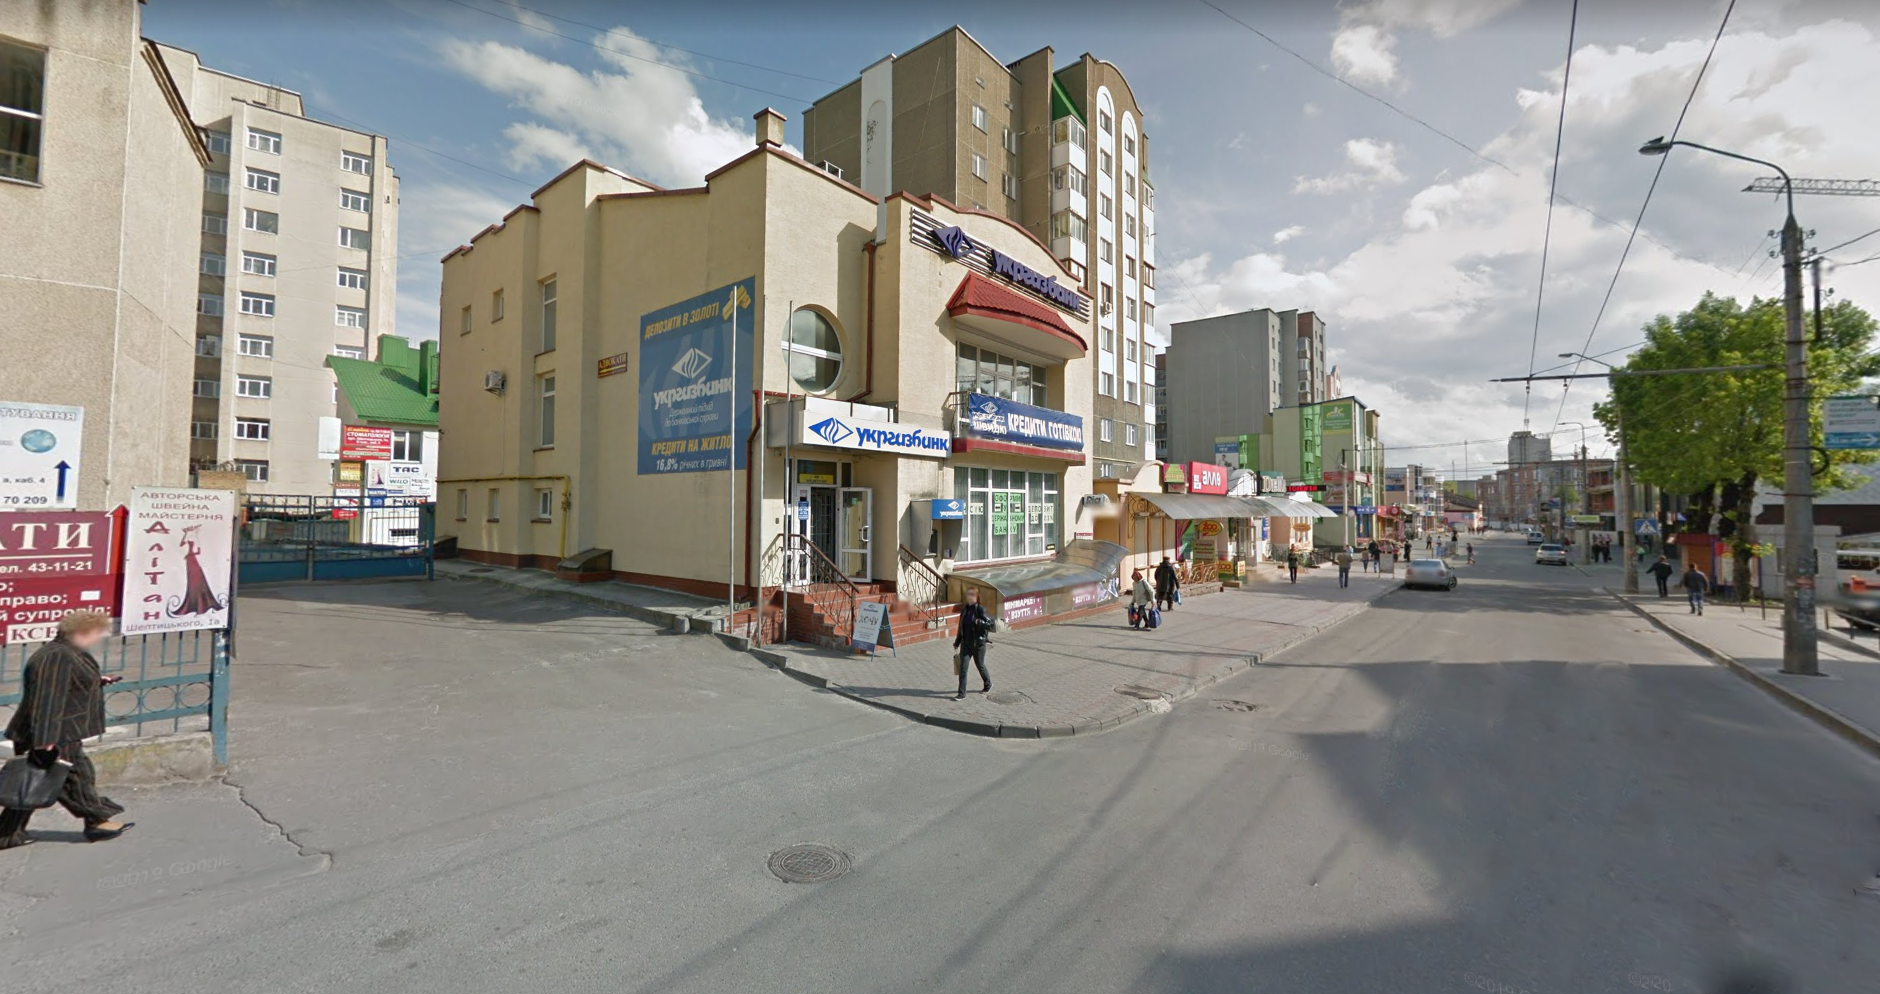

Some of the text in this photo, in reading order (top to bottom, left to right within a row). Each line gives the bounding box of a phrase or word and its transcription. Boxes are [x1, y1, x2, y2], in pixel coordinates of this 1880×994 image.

[644, 301, 720, 340] ДЕПОЗИТИ В ЗОЛОТІ
[1007, 413, 1047, 437] КРЕДИТИ
[1048, 421, 1082, 443] ГОТІВКОЮ
[651, 434, 732, 456] КРЕДИТИ НА ЖИТЛО
[656, 455, 728, 472] 16,8% річних в гривні
[23, 496, 48, 504] 209
[140, 491, 220, 502] АВТОРСЬКА
[151, 502, 210, 511] ШВЕЙНА
[139, 511, 223, 521] МАЙСТЕРНЯ
[28, 561, 92, 572] 43-11-21
[1011, 607, 1031, 620] ВЗУТТЯ
[126, 618, 220, 632] Шептицького, 1а
